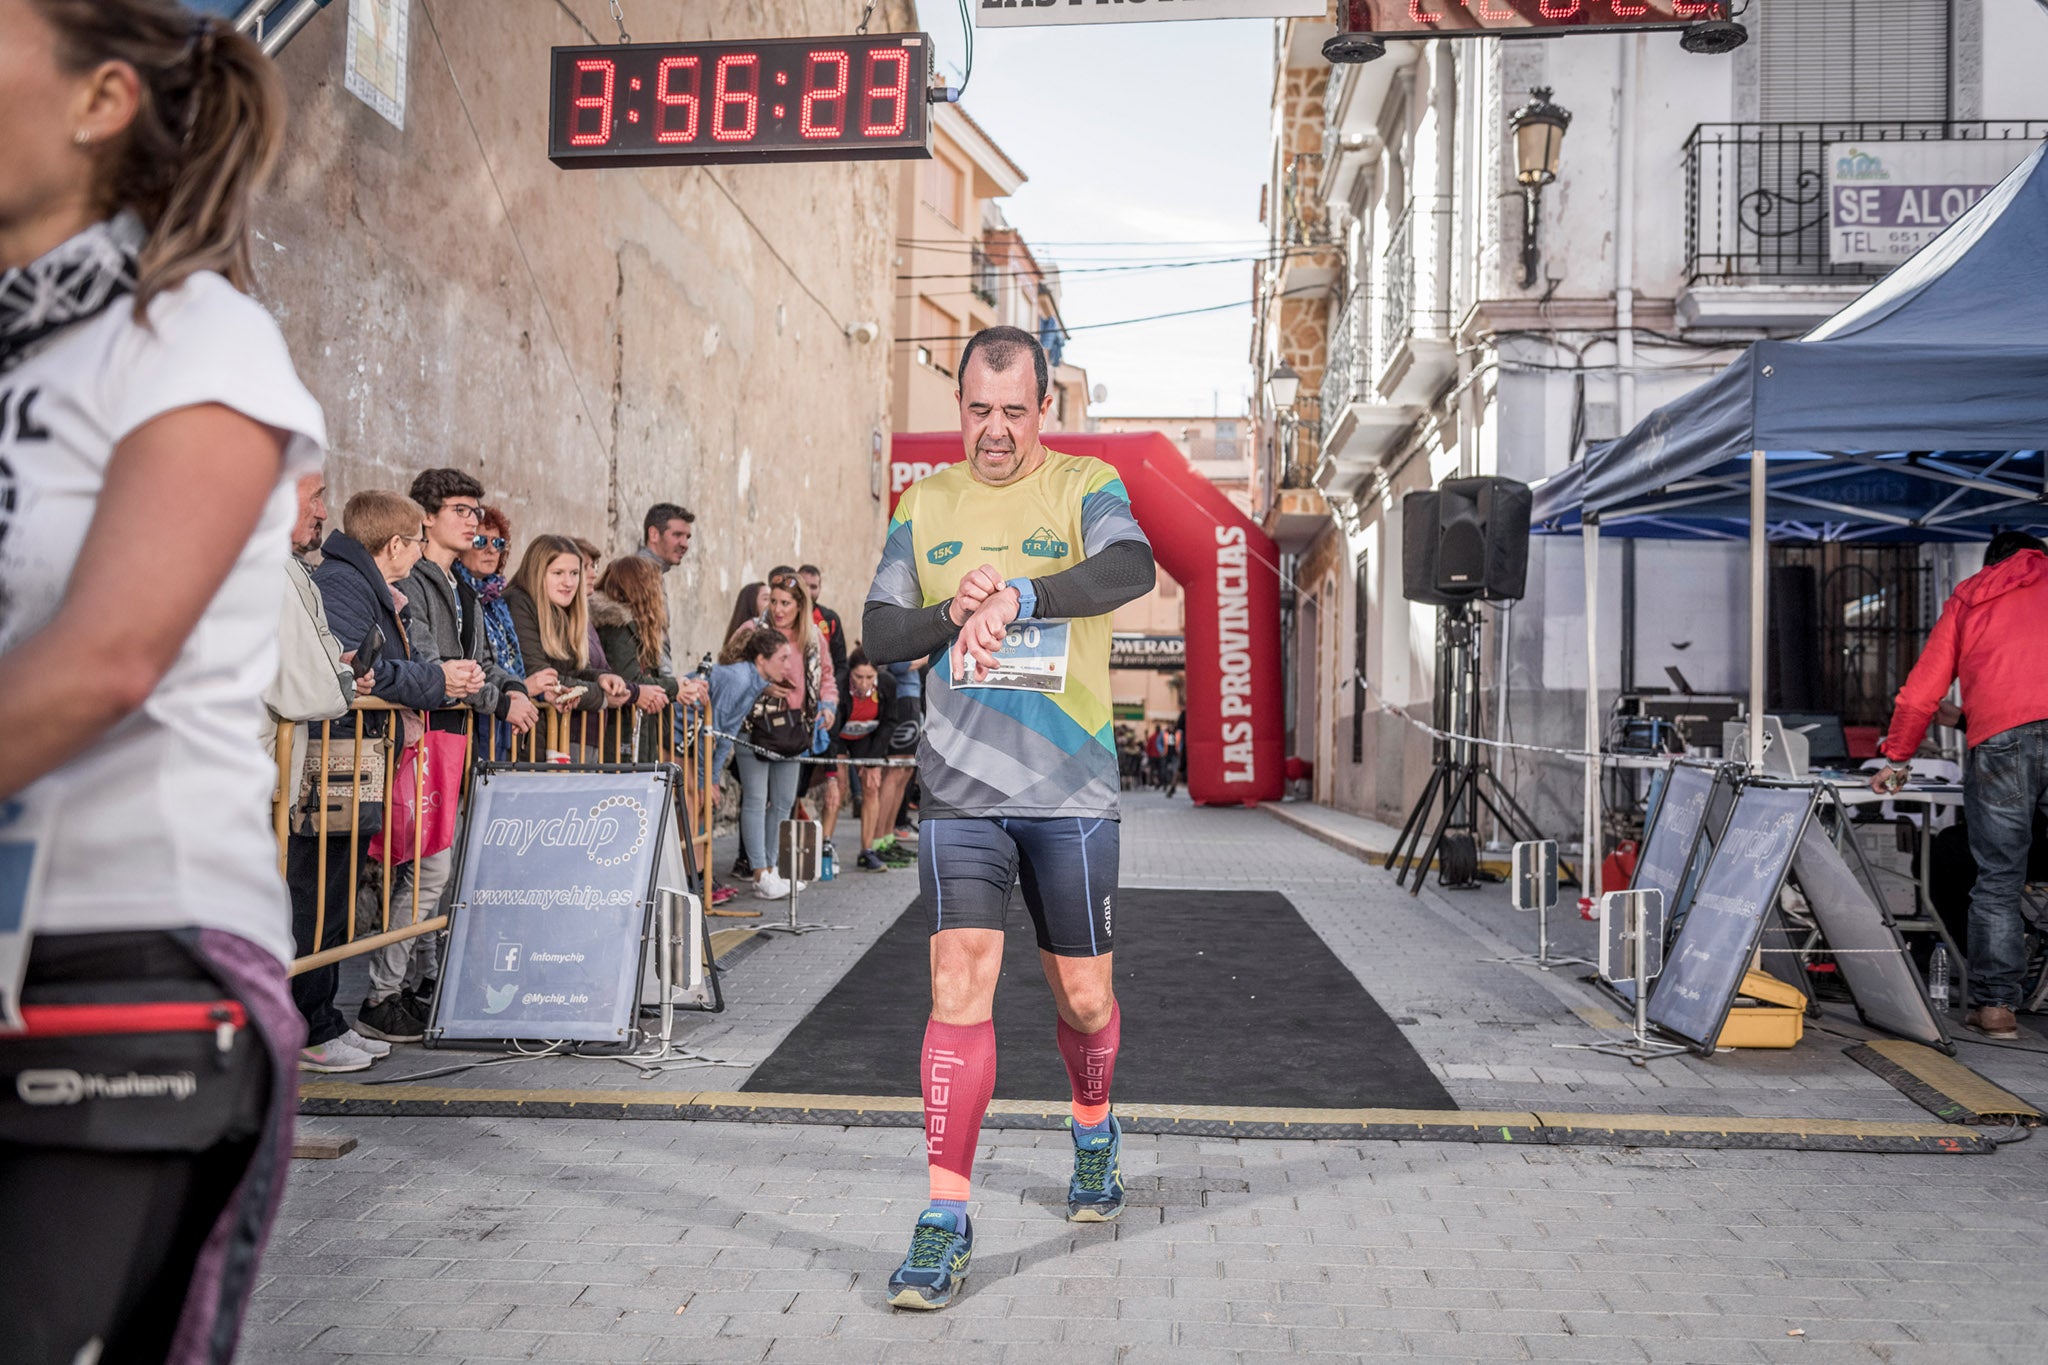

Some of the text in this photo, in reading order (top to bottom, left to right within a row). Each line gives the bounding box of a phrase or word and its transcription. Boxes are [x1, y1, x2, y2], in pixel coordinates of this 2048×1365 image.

[569, 48, 911, 146] 3:56:23
[1839, 188, 1881, 225] SE
[933, 545, 954, 560] 15K
[1215, 525, 1255, 783] LAS PROVINCIAS
[483, 806, 620, 856] mychip
[471, 885, 633, 911] www.mychip.es
[529, 951, 585, 963] /infomychip
